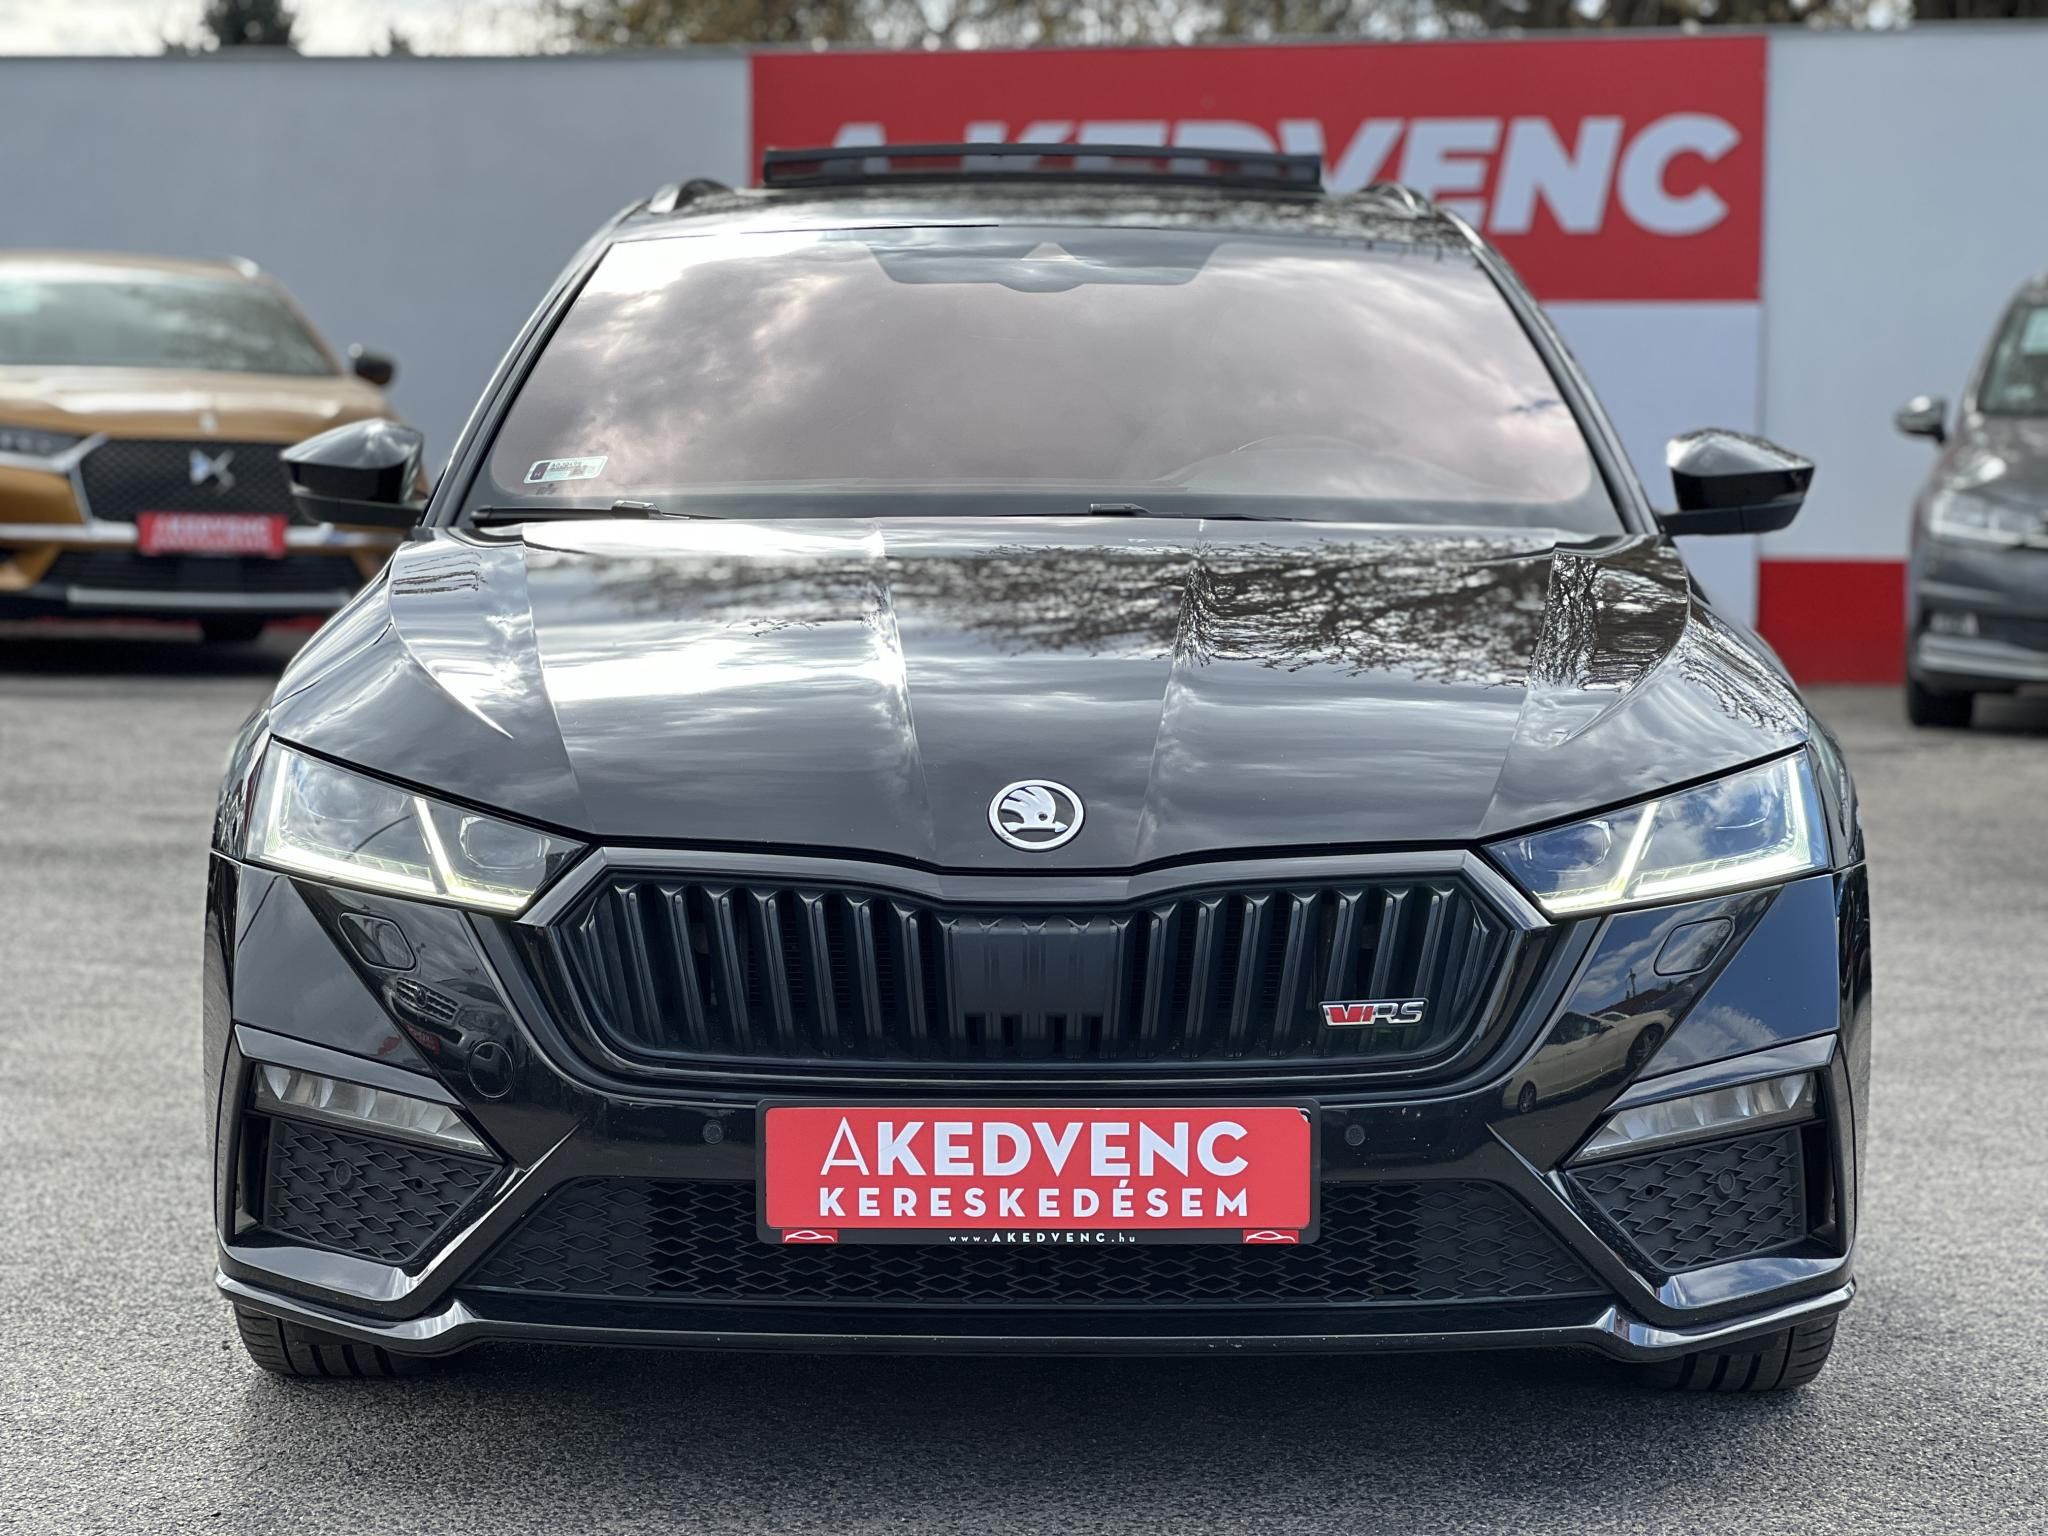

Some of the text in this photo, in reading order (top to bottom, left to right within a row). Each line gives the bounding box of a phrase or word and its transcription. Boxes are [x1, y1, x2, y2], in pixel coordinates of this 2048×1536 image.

[820, 1117, 1249, 1177] AKEDVENC
[819, 1179, 1248, 1218] KERESKEDÉSEM
[948, 1232, 1136, 1243] www.AKEDVENC.hu
